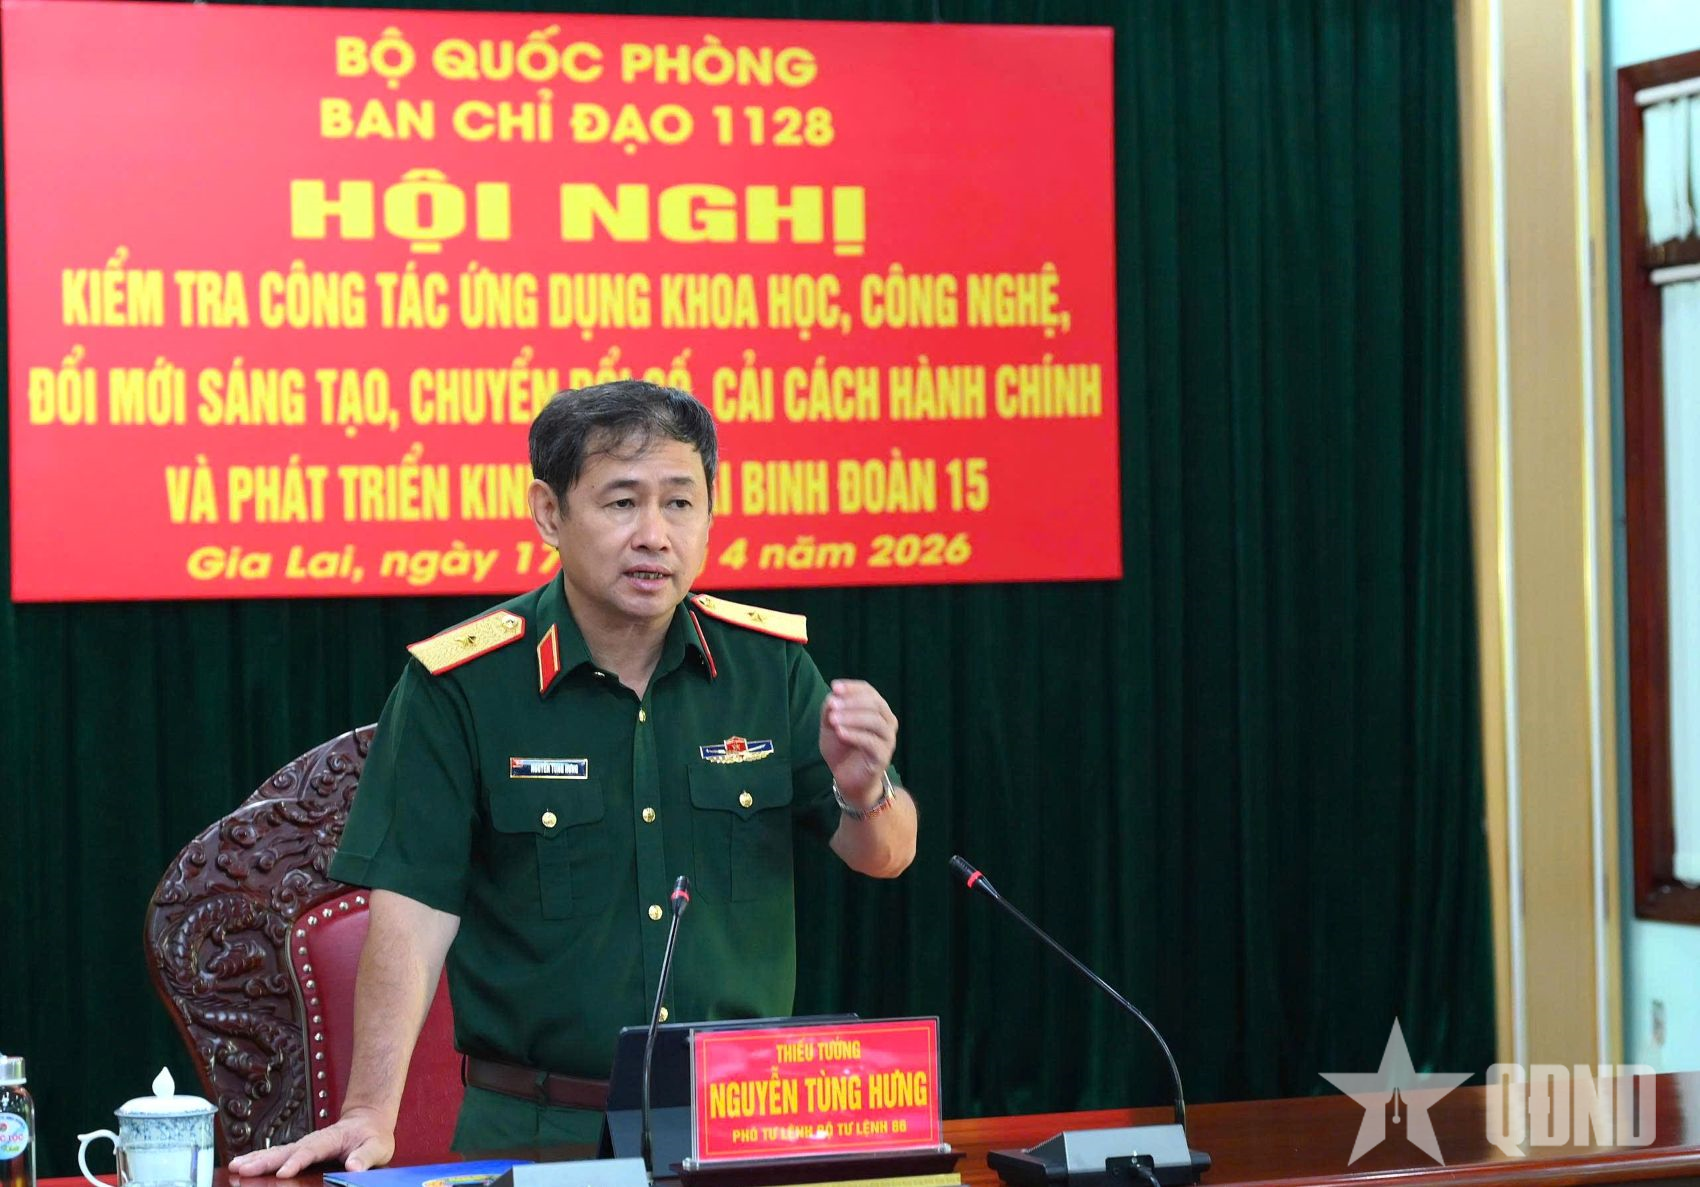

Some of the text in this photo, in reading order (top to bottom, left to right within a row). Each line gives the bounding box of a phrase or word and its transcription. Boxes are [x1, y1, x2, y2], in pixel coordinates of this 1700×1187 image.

[335, 25, 817, 89] BỘ QUỐC PHÒNG
[319, 88, 834, 154] BAN CHỈ ĐẠO 1128
[290, 168, 866, 256] HỘI NGHỊ
[61, 246, 1070, 341] KIỂM TRA CÔNG TÁC ỨNG DỤNG KHOA HỌC, CÔNG NGHỆ,
[27, 345, 98, 426] ĐỔI
[108, 355, 187, 426] MỚI
[197, 357, 307, 426] SÁNG
[314, 367, 400, 437] TẠO,
[410, 345, 560, 426] CHUYỂN
[712, 349, 774, 423] CẢI
[784, 366, 880, 422] CÁCH
[889, 355, 986, 420] HÀNH
[996, 353, 1101, 418] CHÍNH
[165, 455, 219, 524] VÀ
[227, 454, 329, 523] PHÁT
[337, 443, 451, 522] TRIỂN
[460, 463, 534, 520] KIN
[741, 460, 829, 515] BINH
[838, 448, 936, 514] ĐOÀN
[947, 458, 989, 511] 15
[186, 544, 273, 580] Gia
[285, 544, 364, 584] Lai,
[380, 540, 498, 587] ngày
[515, 540, 561, 575] 17
[718, 537, 748, 570] 4
[759, 534, 857, 571] năm
[868, 533, 972, 568] 2026
[776, 1036, 861, 1063] THIẾU TƯỚNG
[710, 1066, 928, 1118] NGUYỄN TÙNG HƯNG
[733, 1128, 759, 1143] PHÓ
[763, 1127, 778, 1141] TƯ
[837, 1121, 853, 1136] TƯ
[856, 1119, 888, 1136] LỆNH
